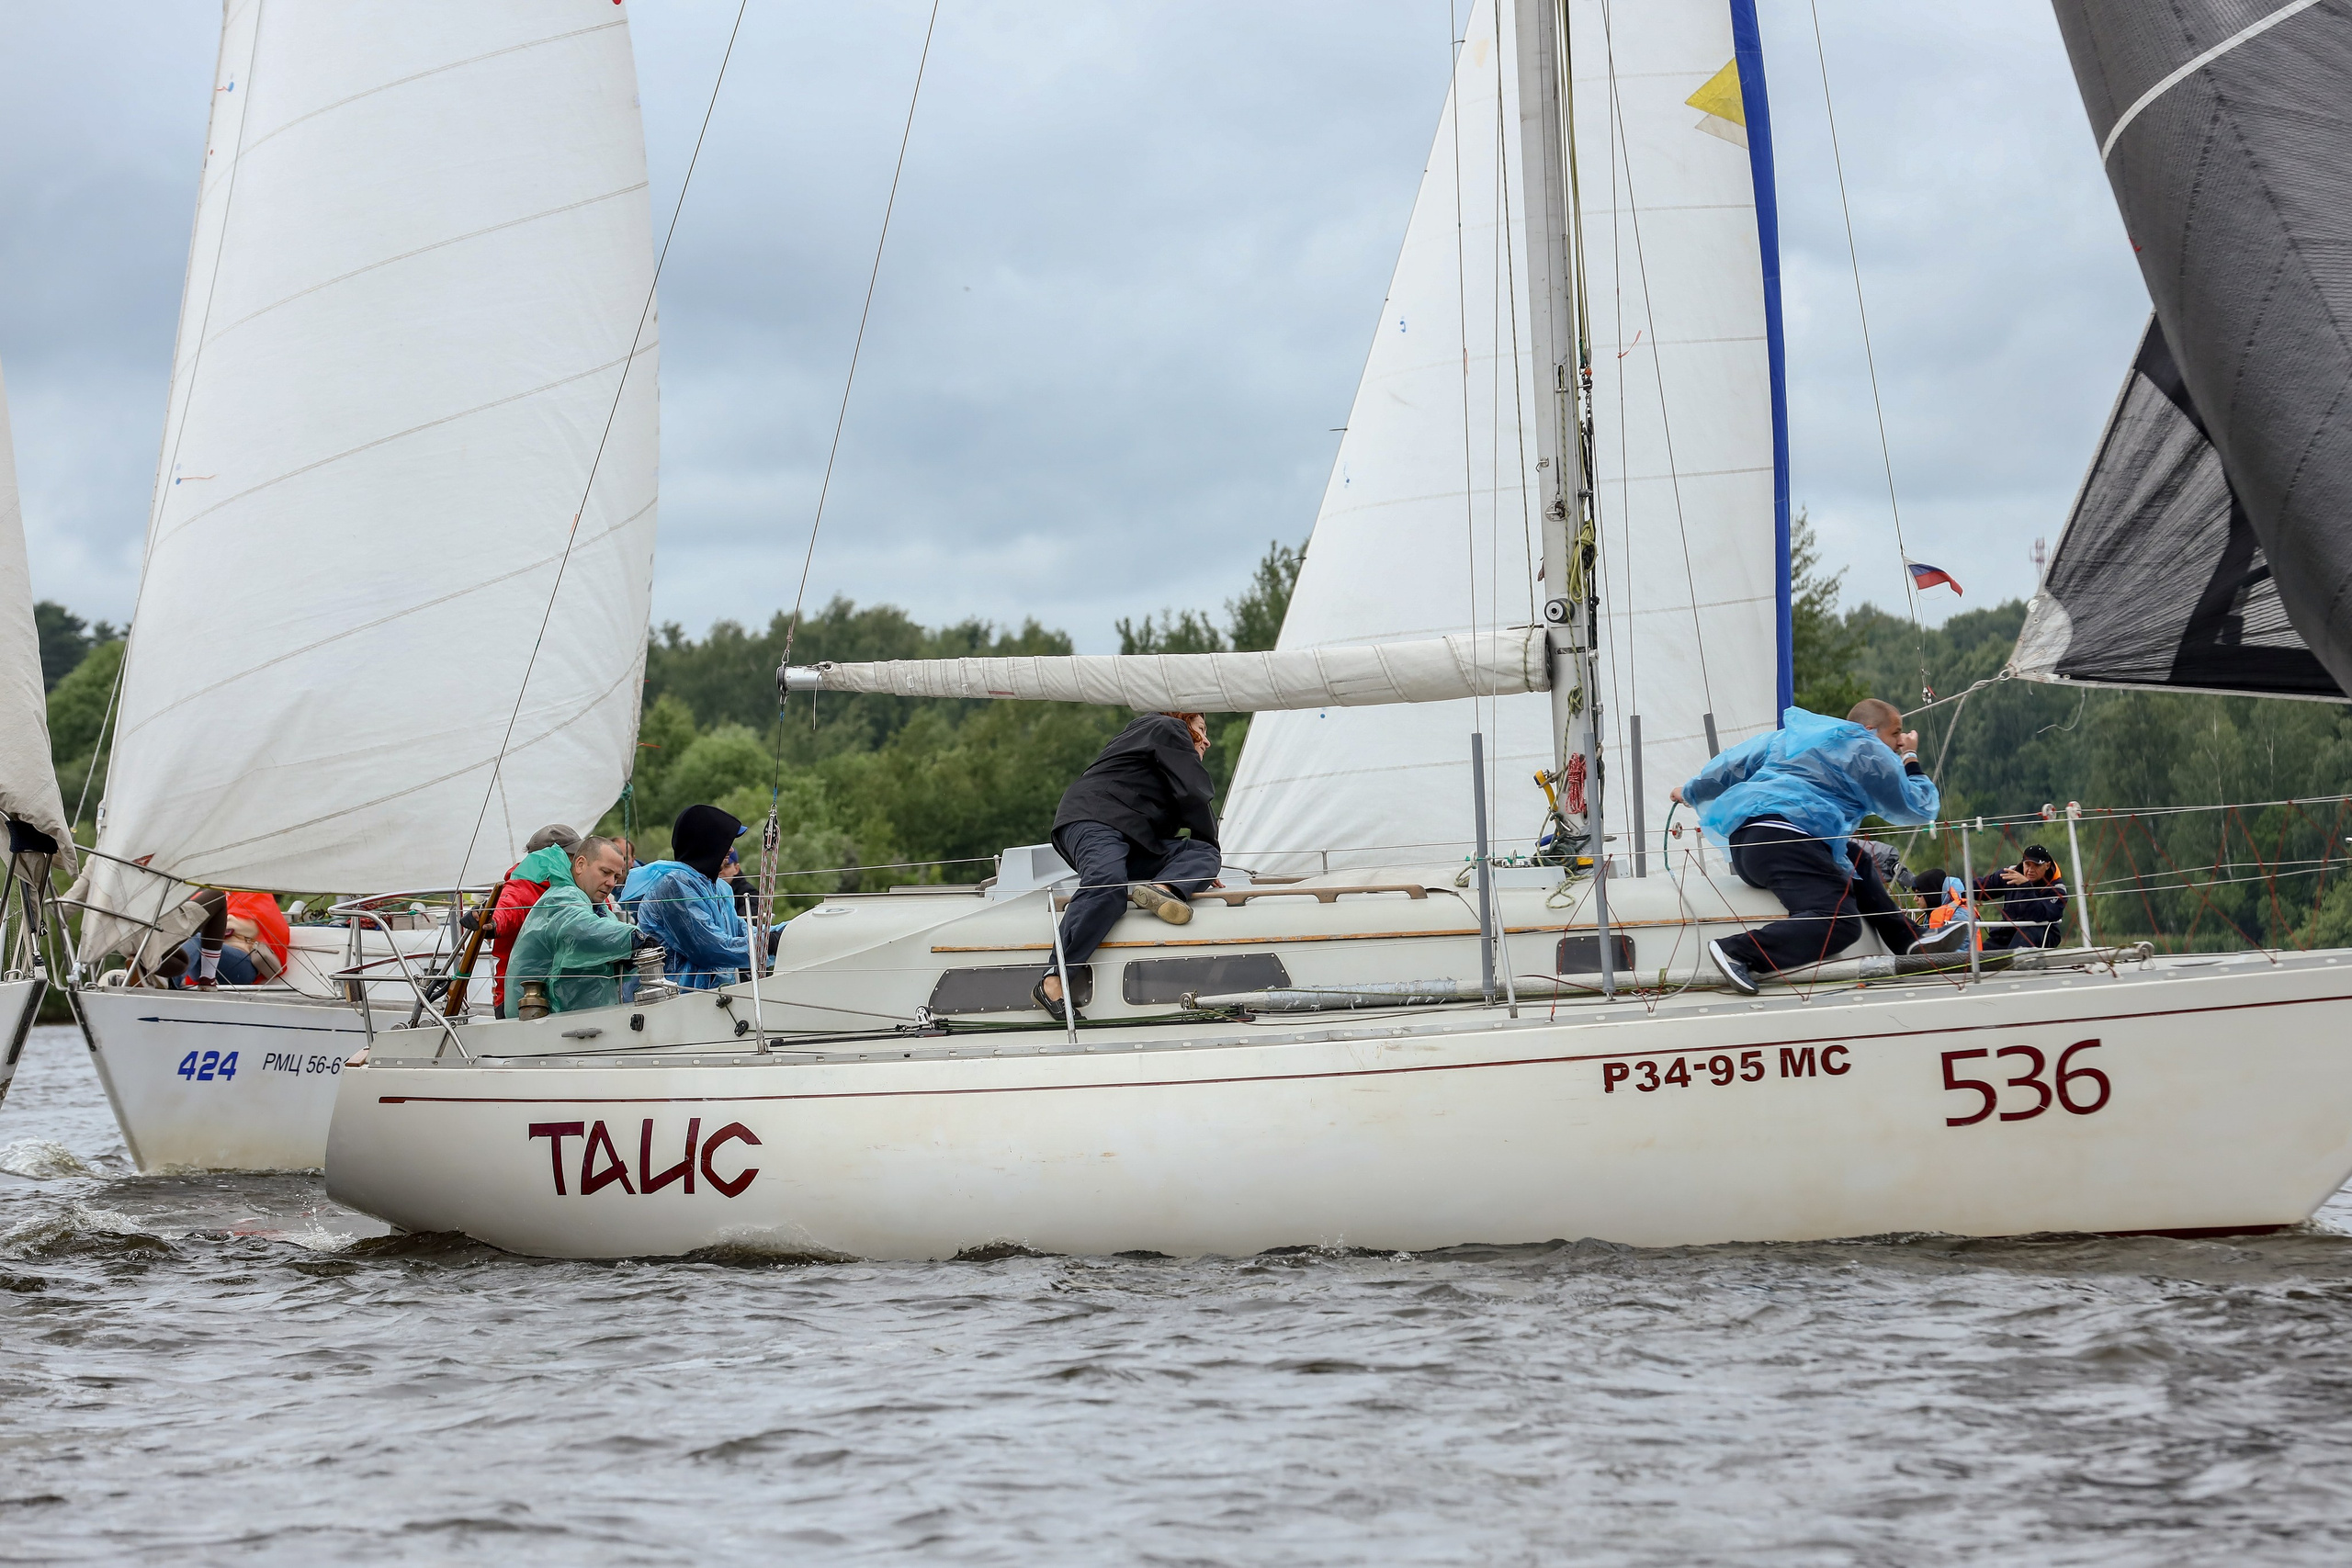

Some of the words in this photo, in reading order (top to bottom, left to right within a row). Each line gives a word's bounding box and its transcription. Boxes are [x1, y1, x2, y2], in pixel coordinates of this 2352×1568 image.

[177, 1050, 240, 1081] 424
[262, 1053, 303, 1077] РМЦ
[305, 1055, 350, 1076] 56-6
[1940, 1038, 2111, 1127] 536
